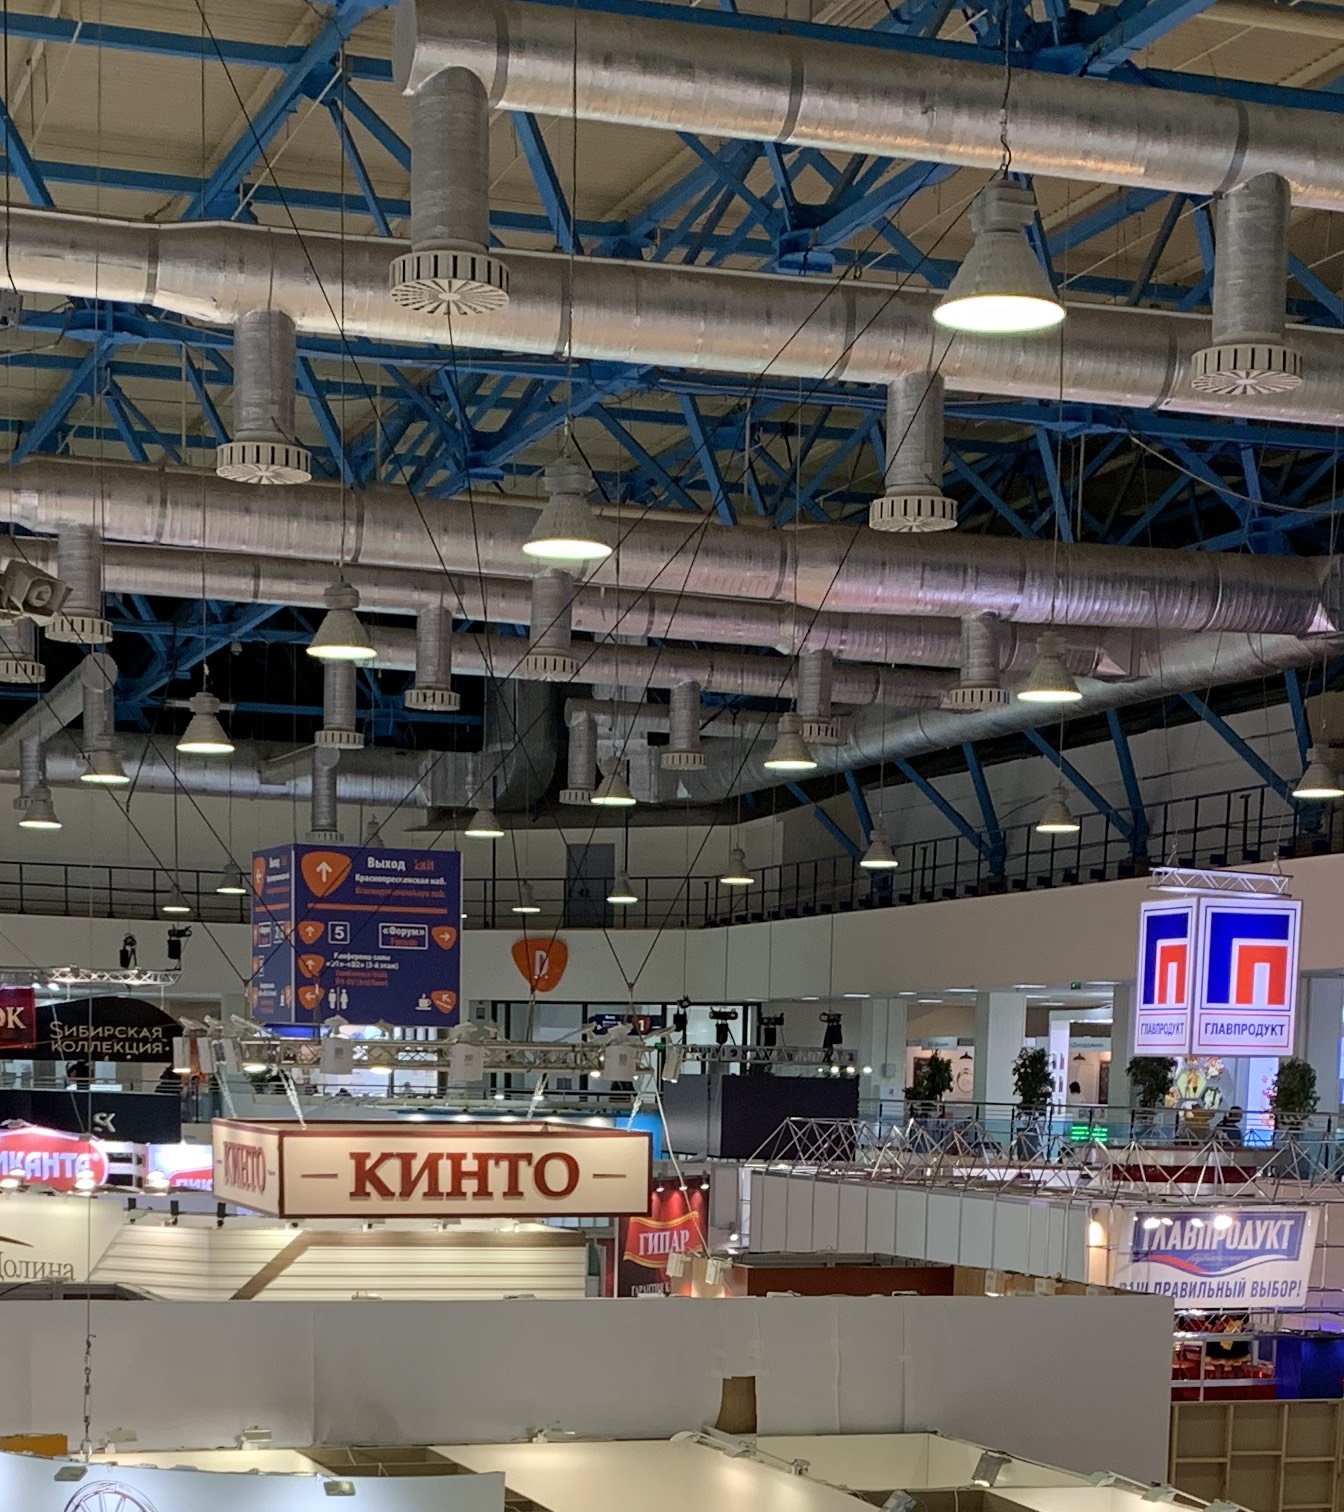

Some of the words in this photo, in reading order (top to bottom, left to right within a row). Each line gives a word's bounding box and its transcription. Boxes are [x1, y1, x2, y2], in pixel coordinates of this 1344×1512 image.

[367, 856, 406, 871] Выход
[334, 926, 345, 939] 5
[1140, 1022, 1185, 1036] ГЛАВПРОДУКТ
[1205, 1022, 1286, 1038] ГЛАВПРОДУКТ
[222, 1141, 267, 1196] КИНТО
[348, 1151, 581, 1201] КИНТО
[638, 1229, 690, 1256] ГИПАР
[1142, 1219, 1296, 1251] ГЛАВПРОДУКТ
[1156, 1277, 1246, 1299] ПРАВИЛЬНЫЙ
[1250, 1279, 1302, 1298] ВЫБОР!
